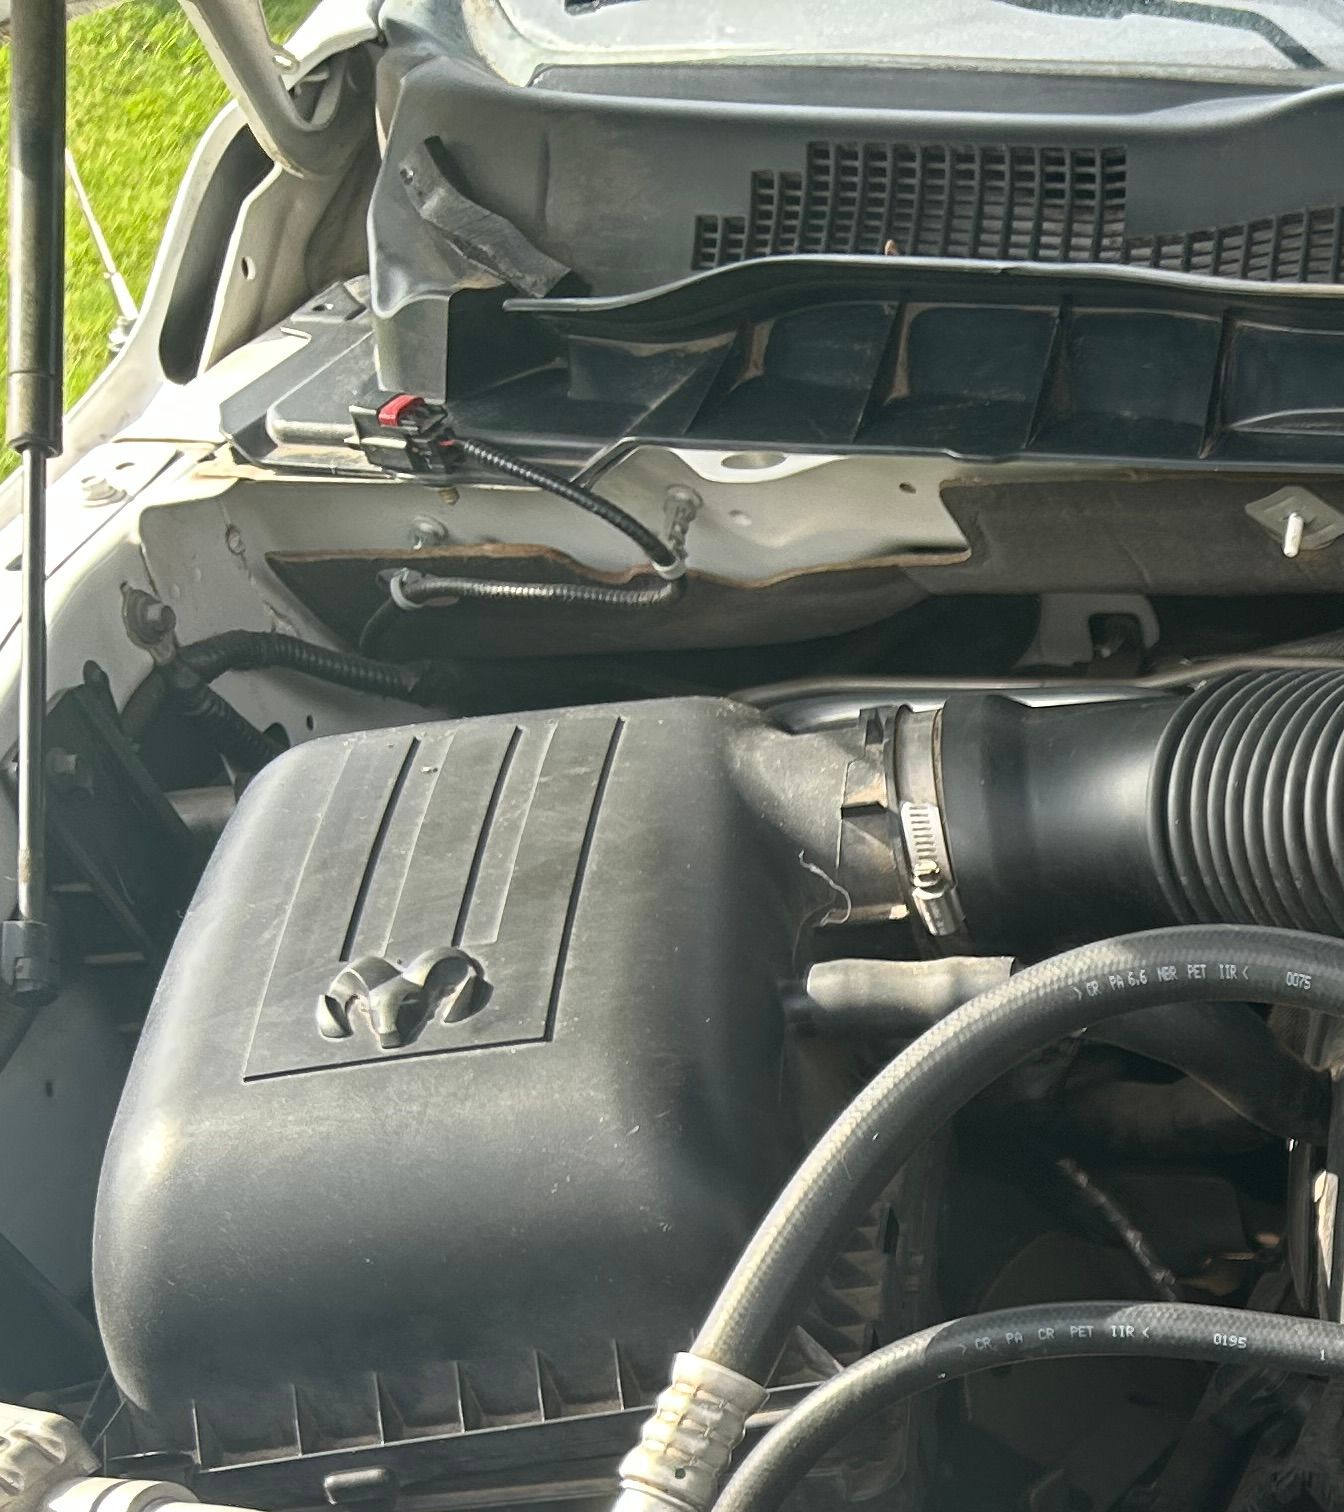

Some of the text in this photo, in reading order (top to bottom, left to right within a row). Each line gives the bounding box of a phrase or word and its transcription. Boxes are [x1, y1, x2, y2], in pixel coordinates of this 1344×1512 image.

[1109, 975, 1125, 992] PA
[1187, 963, 1208, 980] PET
[1218, 964, 1238, 980] IIR
[974, 1336, 992, 1351] CR
[1006, 1332, 1023, 1345] PA
[1038, 1327, 1055, 1340] CR
[1070, 1325, 1094, 1339] PET
[1111, 1325, 1135, 1338] IIR
